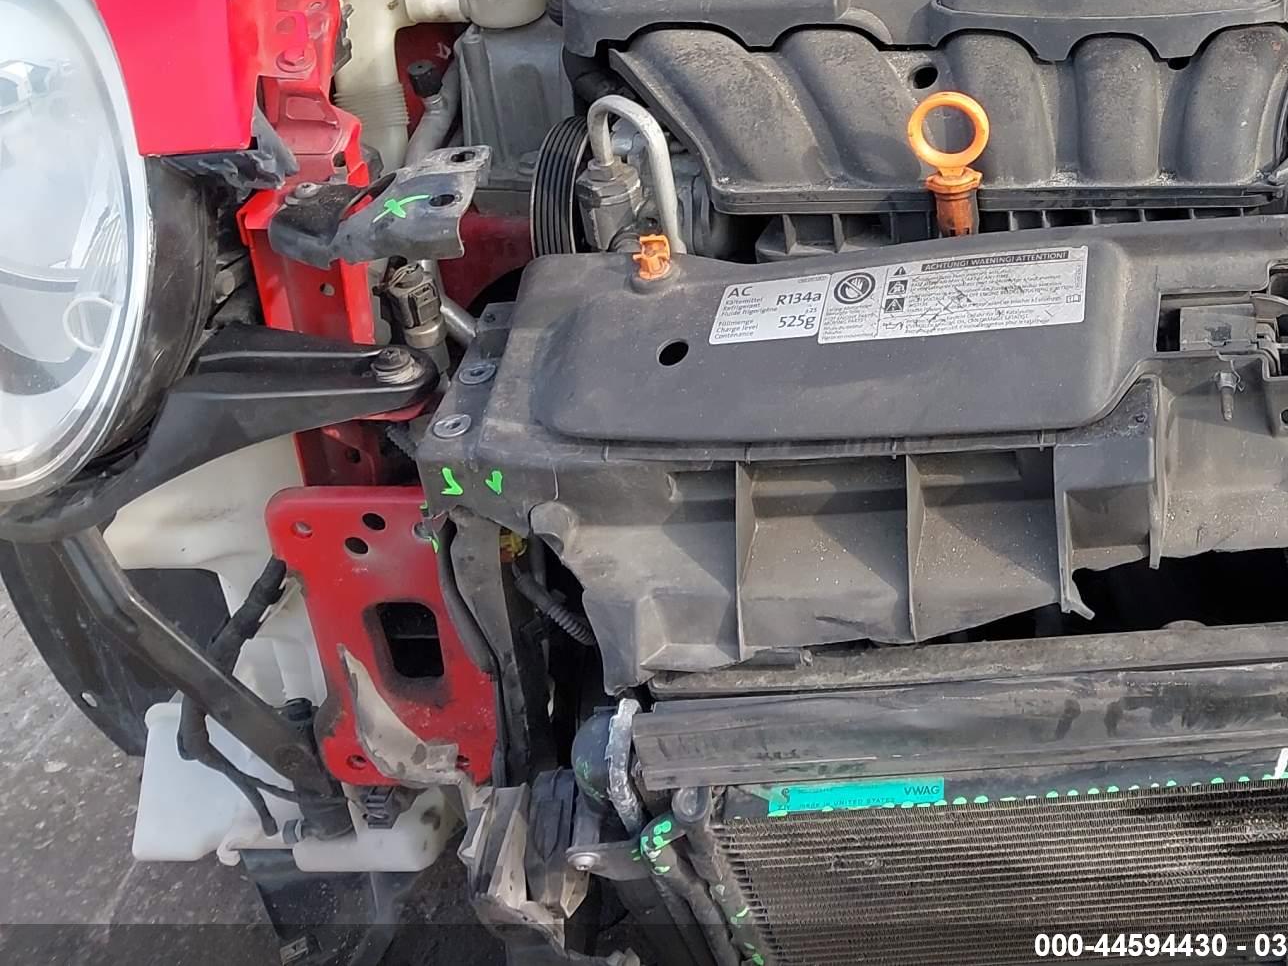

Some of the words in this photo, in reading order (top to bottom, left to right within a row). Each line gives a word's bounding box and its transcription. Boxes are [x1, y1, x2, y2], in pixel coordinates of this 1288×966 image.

[1016, 251, 1066, 263] ATTENTION!
[727, 286, 752, 299] AC
[776, 291, 822, 306] R134a
[778, 314, 817, 330] 525g
[904, 784, 940, 797] VWAG
